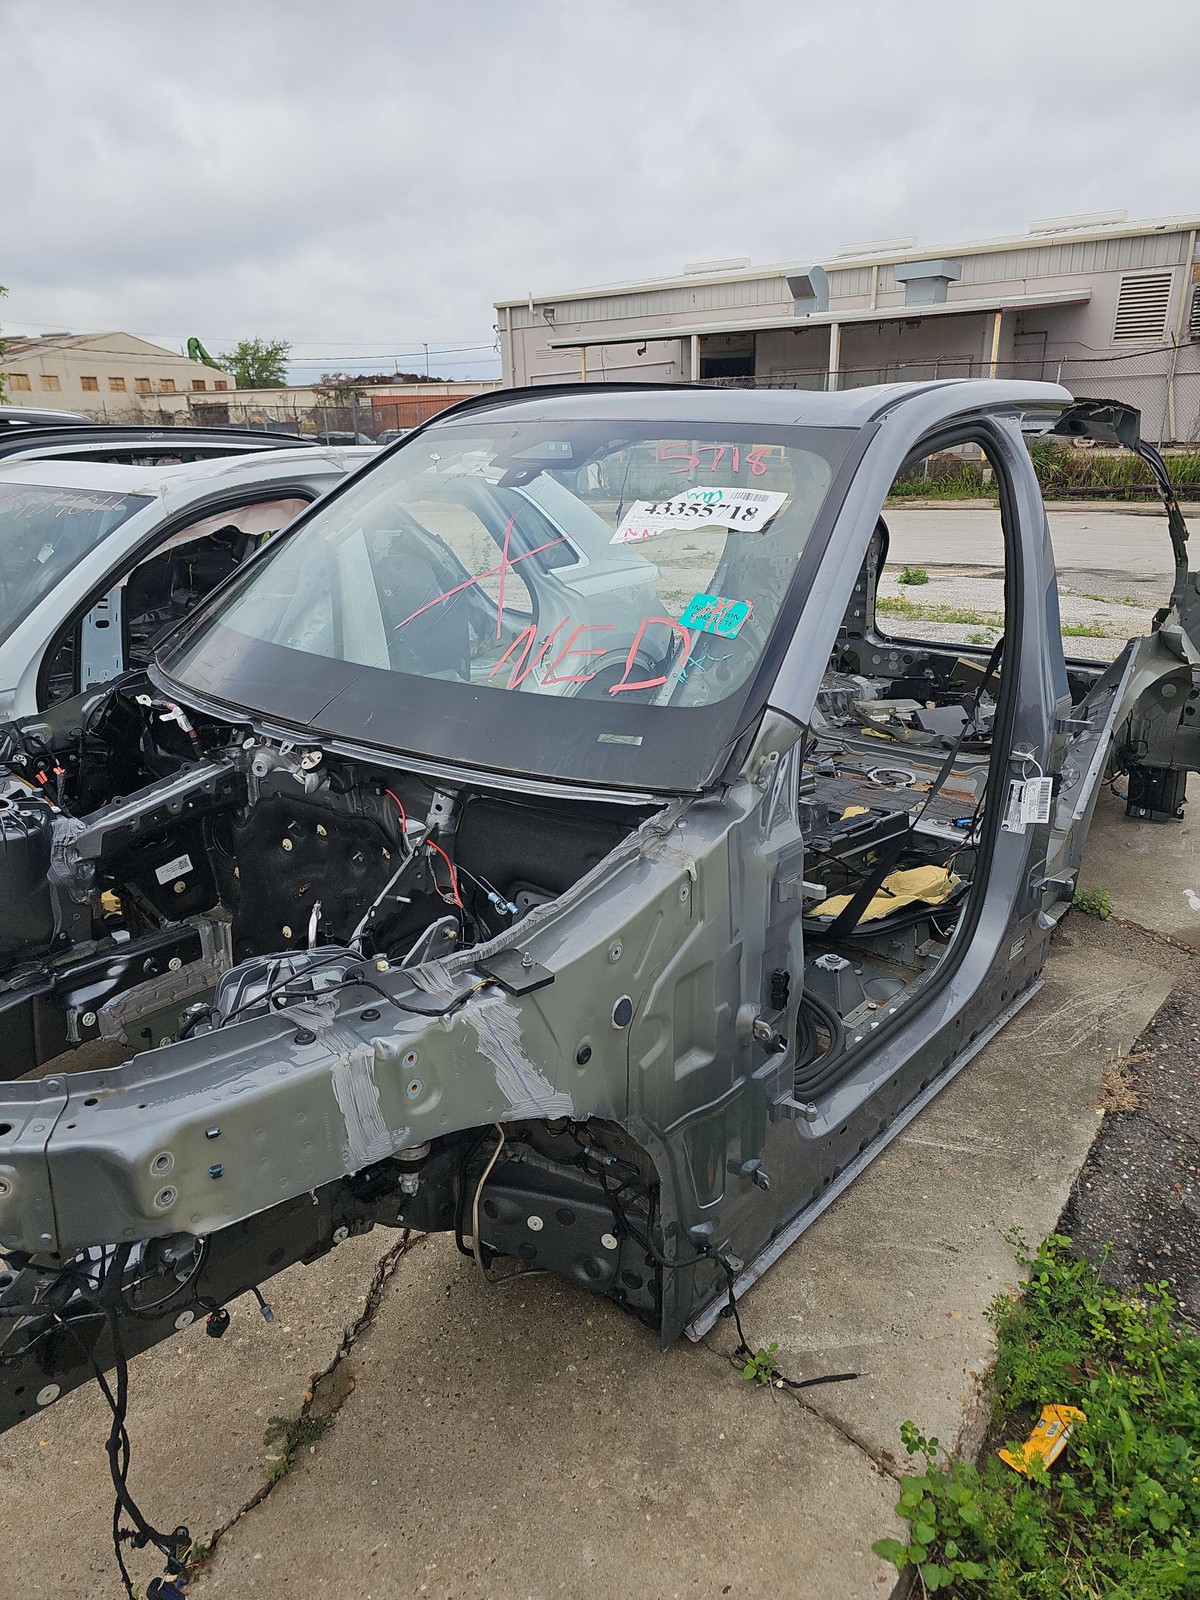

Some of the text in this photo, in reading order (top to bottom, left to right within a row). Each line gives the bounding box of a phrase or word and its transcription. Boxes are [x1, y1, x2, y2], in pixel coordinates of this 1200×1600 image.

[660, 443, 770, 476] 5718
[644, 502, 759, 521] 43355718
[690, 612, 735, 627] COMLETE
[691, 604, 741, 621] INSPION
